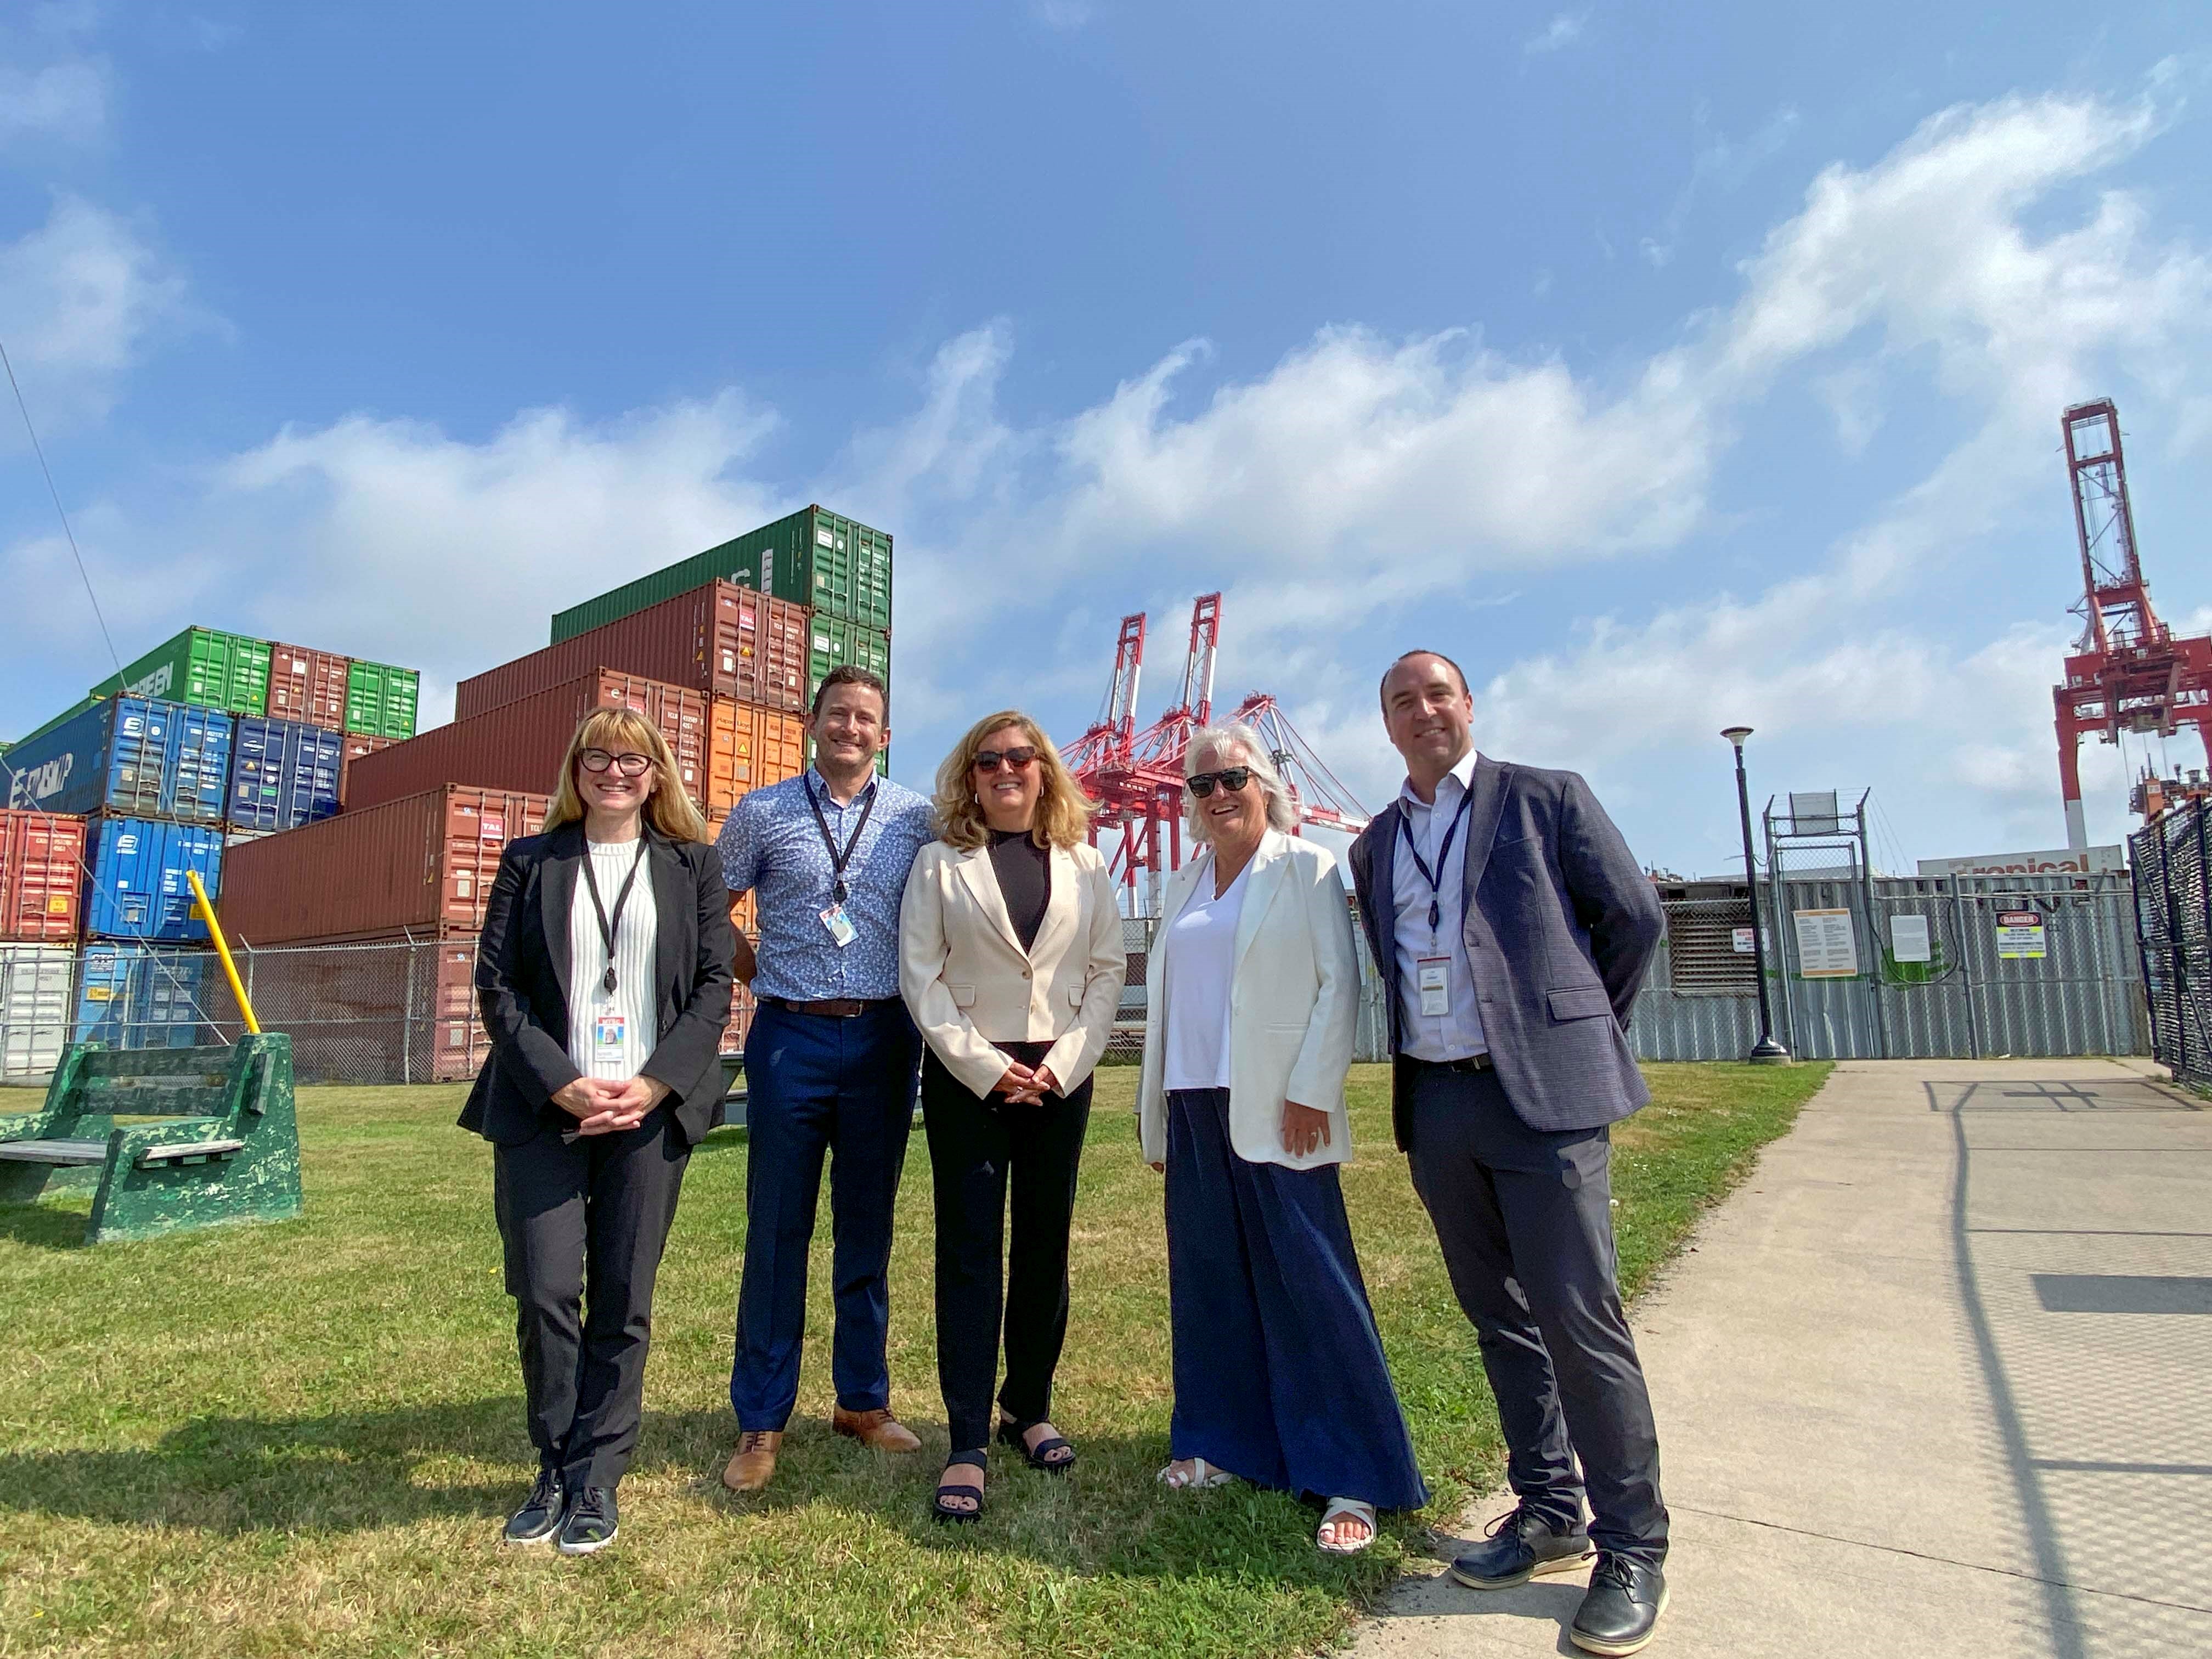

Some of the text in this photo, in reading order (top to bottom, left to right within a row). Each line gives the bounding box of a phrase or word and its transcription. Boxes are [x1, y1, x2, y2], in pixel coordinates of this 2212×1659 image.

[741, 615, 754, 624] TAL
[127, 661, 174, 696] REEN
[667, 711, 678, 720] TCLU
[716, 716, 751, 729] HapagLloyd
[483, 823, 503, 832] TAL
